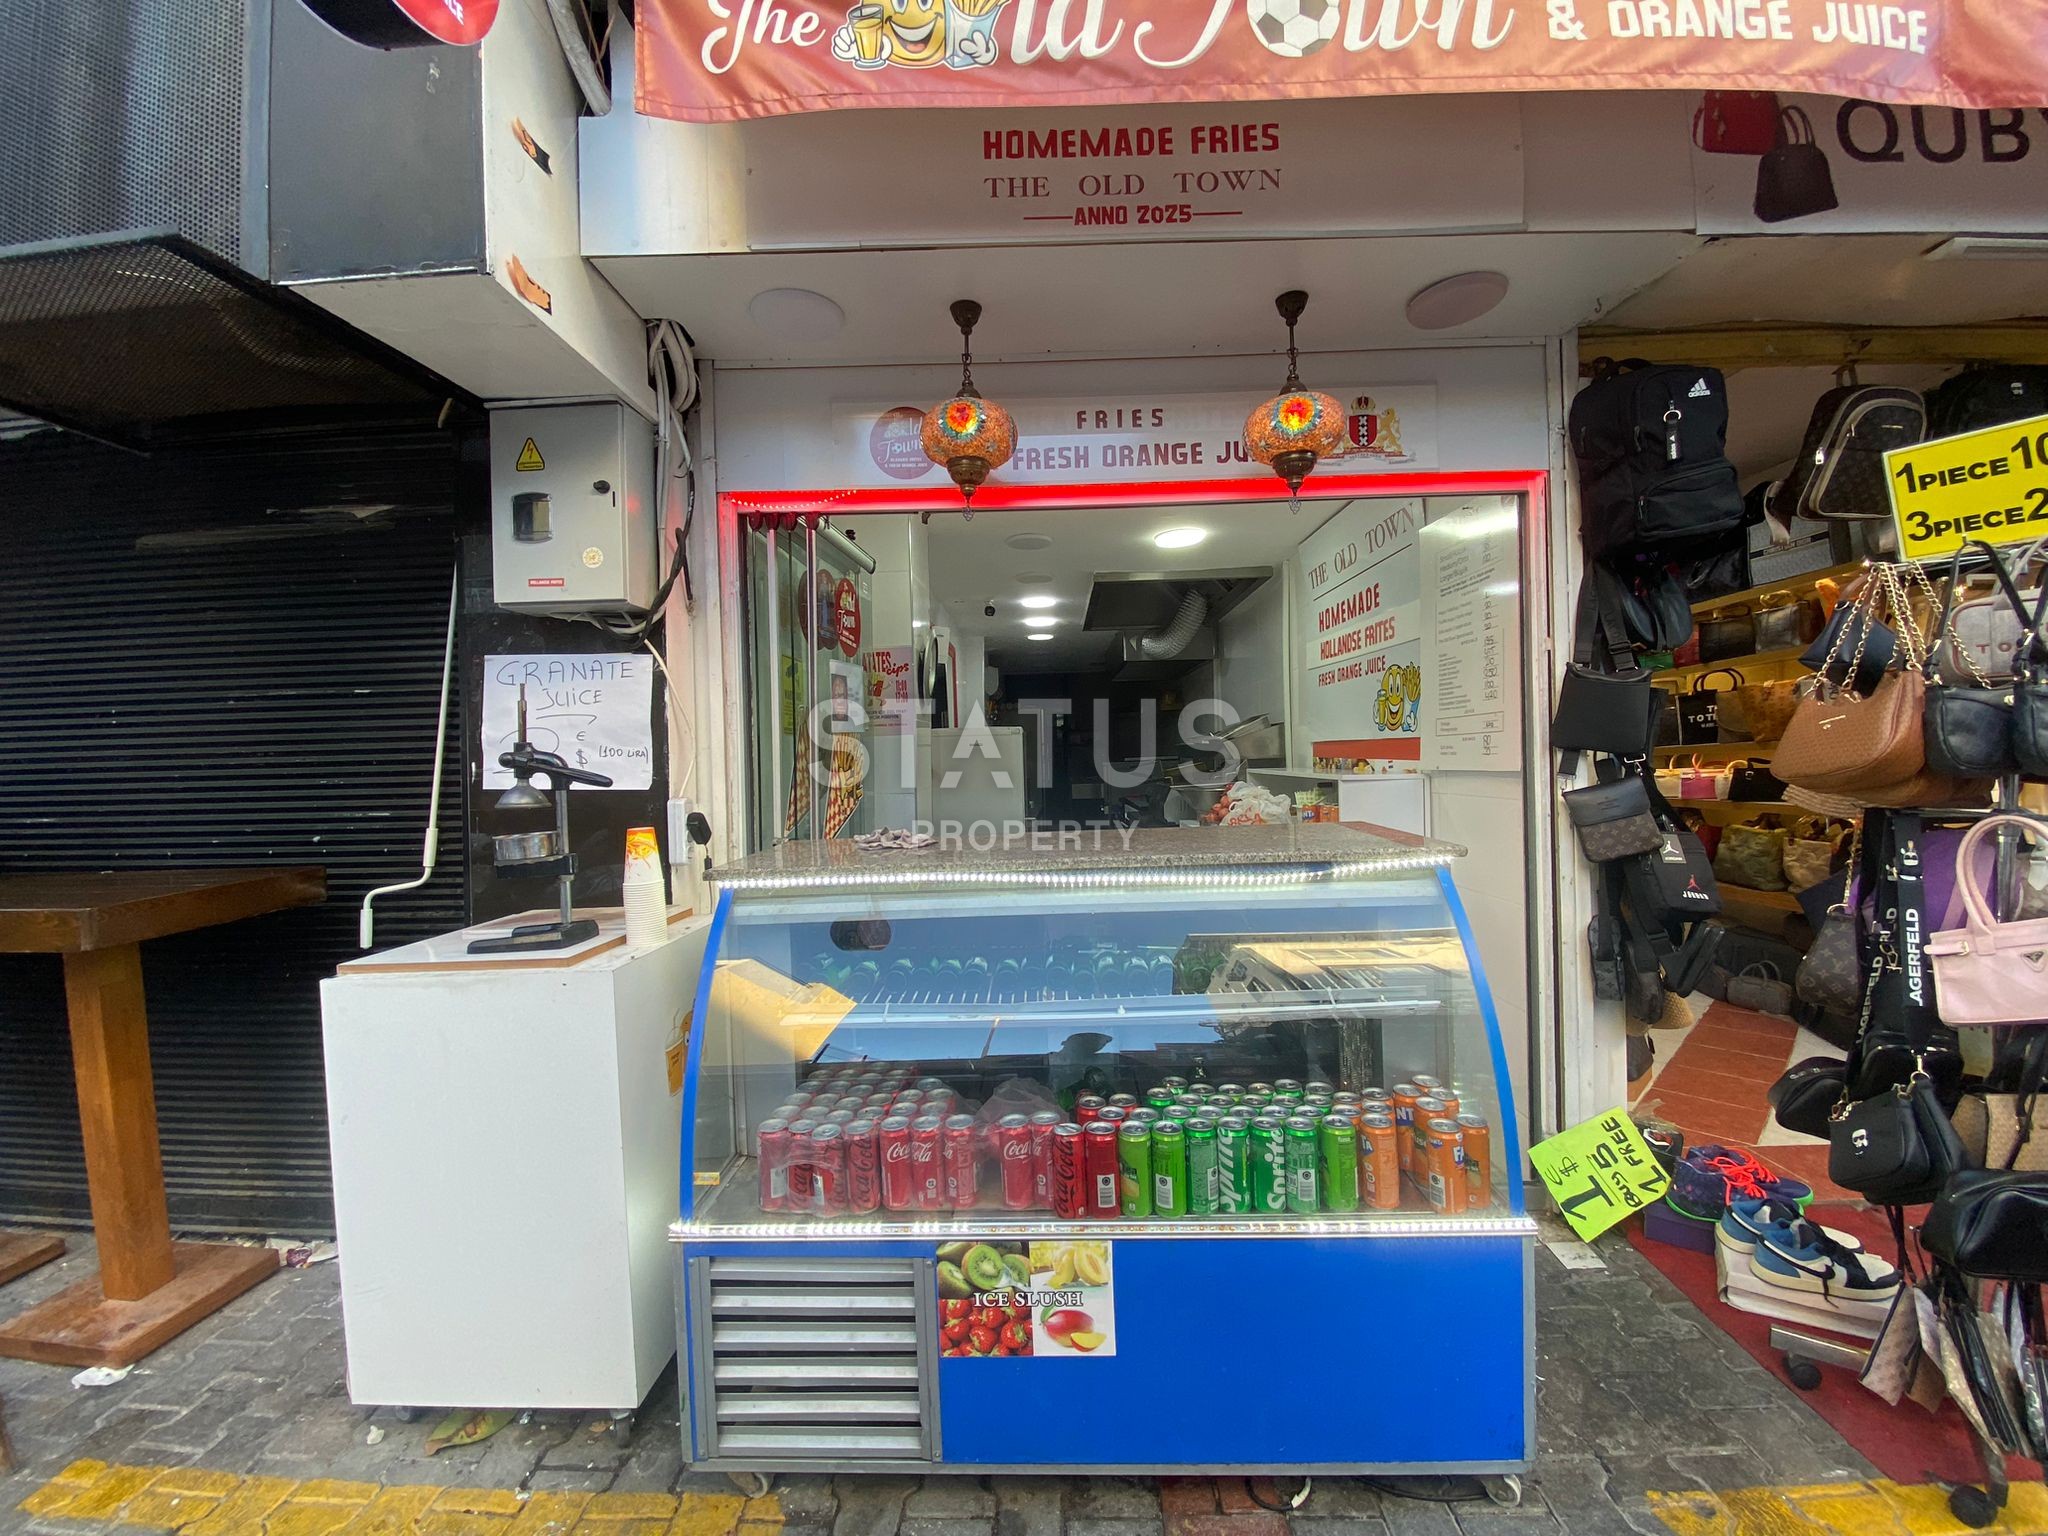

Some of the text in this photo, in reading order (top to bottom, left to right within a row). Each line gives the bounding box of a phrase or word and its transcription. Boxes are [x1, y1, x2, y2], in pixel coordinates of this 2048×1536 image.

[1546, 0, 1588, 40] &
[1608, 0, 1793, 39] ORANGE
[1812, 2, 1928, 54] JUICE
[983, 123, 1280, 160] HOMEMADE FRIES
[1837, 99, 2048, 163] QUB
[983, 168, 1282, 198] THE OLD TOWN
[1074, 204, 1192, 226] ANNO 2025
[1688, 389, 1711, 398] adidas
[1077, 408, 1164, 429] FRIES
[1012, 446, 1089, 470] FRESH
[1102, 442, 1203, 467] ORANGE
[1308, 561, 1329, 590] THE
[1334, 542, 1358, 575] OLD
[1364, 502, 1416, 554] TOWN
[1318, 582, 1380, 633] HOMEMADE
[1364, 615, 1396, 649] FRITES
[496, 660, 635, 686] GRANATE
[1318, 655, 1387, 688] FRESH ORANGE JUICE
[1591, 1142, 1619, 1169] 5
[1601, 1116, 1667, 1194] 1 FREE
[1560, 1174, 1614, 1221] 1
[973, 1291, 1083, 1307] ICE SLUSH
